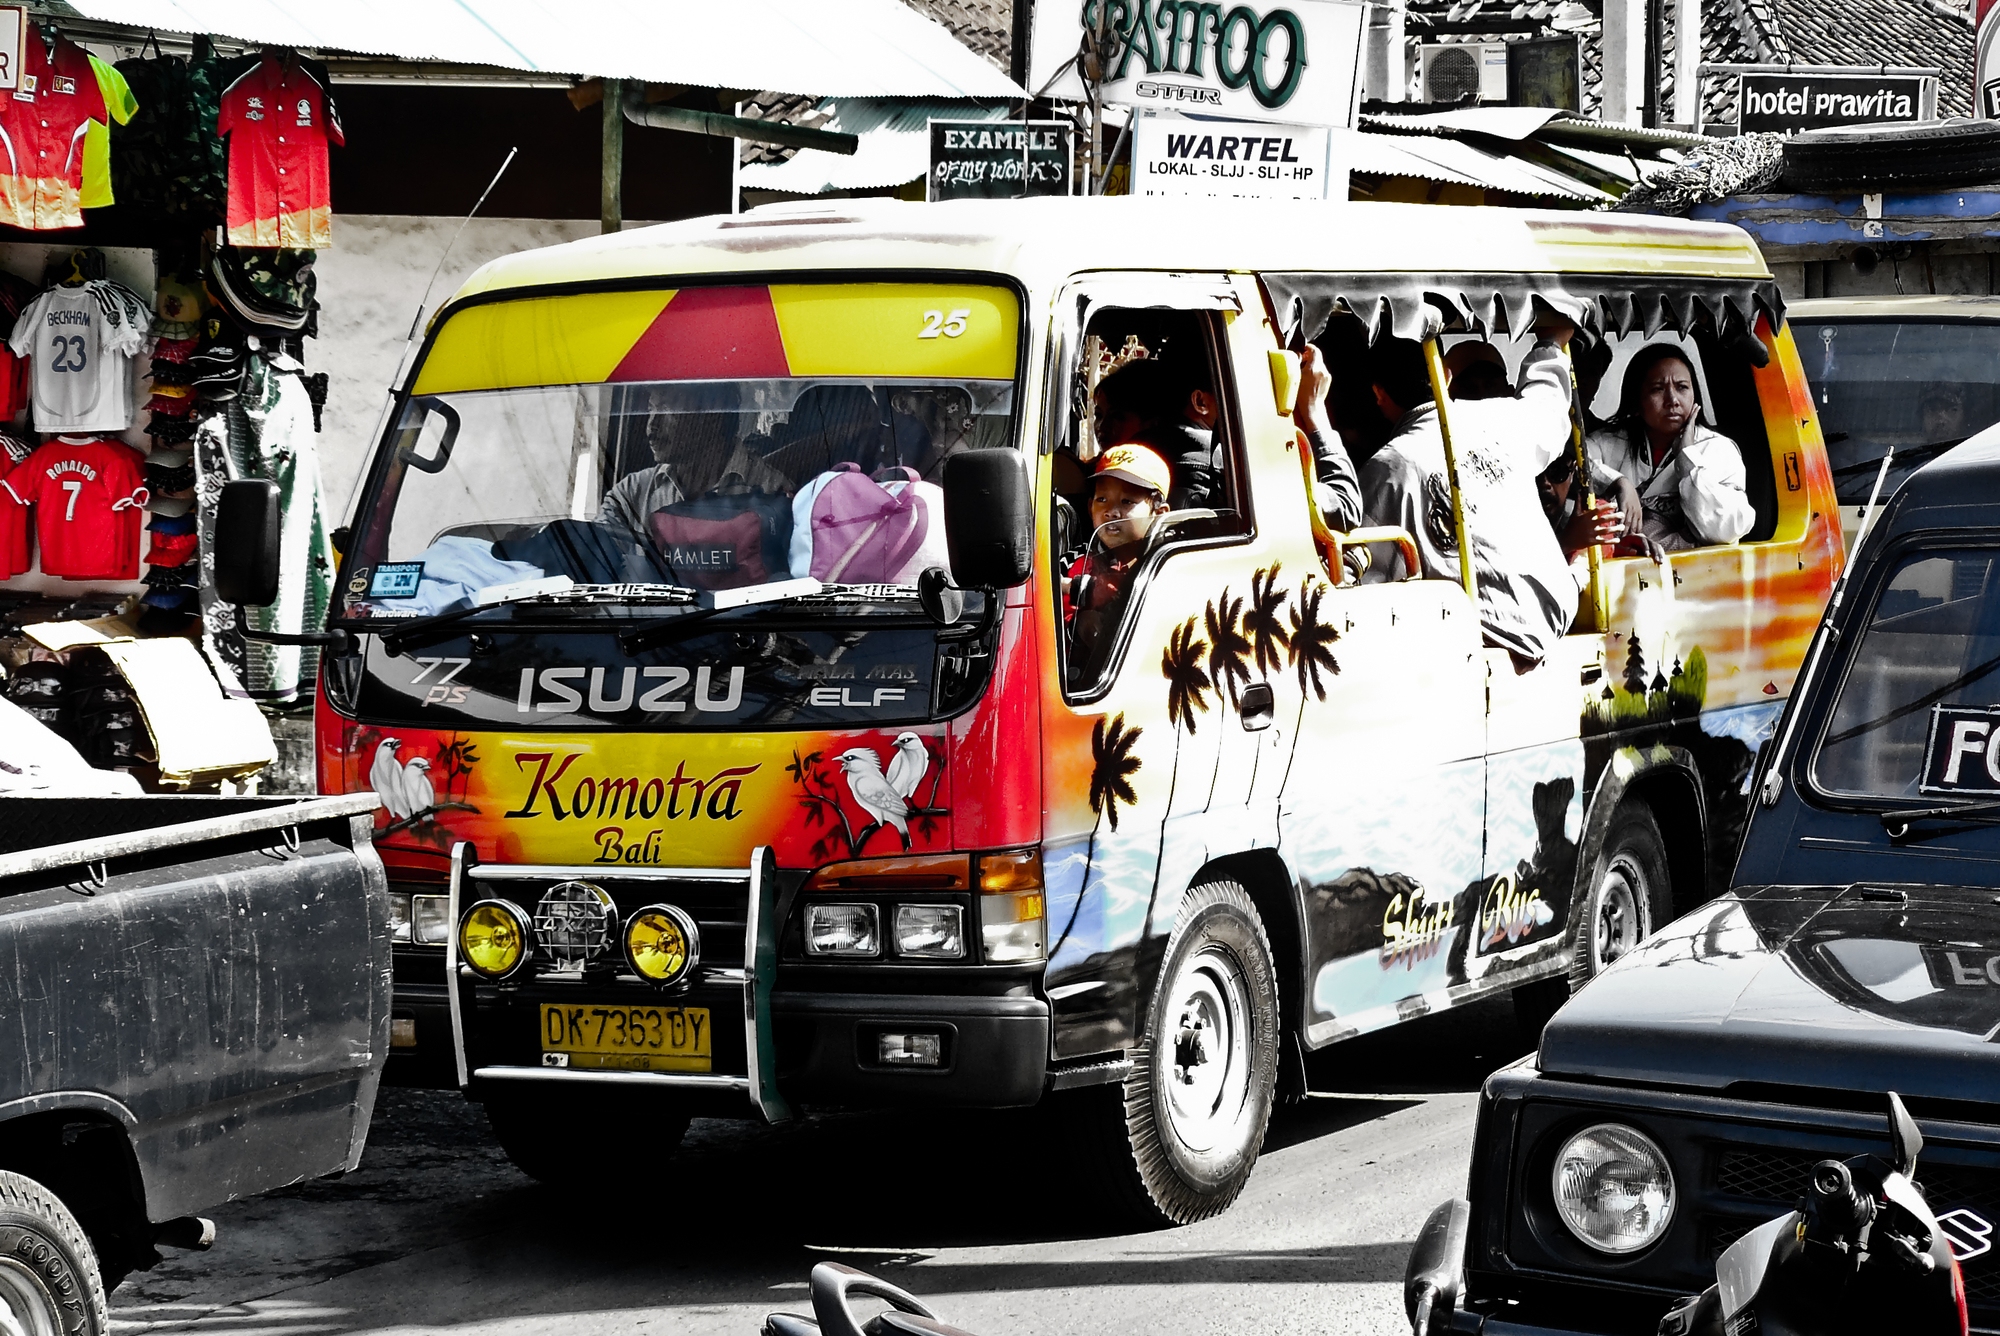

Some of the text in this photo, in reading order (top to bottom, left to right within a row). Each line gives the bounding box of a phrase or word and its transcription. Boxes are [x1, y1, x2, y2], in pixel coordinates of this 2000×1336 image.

[1137, 81, 1222, 105] STAR
[1746, 86, 1912, 117] hotel prawita
[944, 130, 1057, 150] EXAMPLE
[1167, 134, 1298, 163] WARTEL
[1149, 161, 1198, 176] LOKAL
[1211, 164, 1244, 177] SLJJ
[1258, 166, 1280, 179] SLI
[1293, 168, 1313, 180] HP
[47, 310, 90, 327] BECKHAM
[917, 309, 970, 339] 25
[52, 335, 87, 372] 23
[46, 460, 97, 481] RONALDO
[62, 481, 81, 521] 7
[664, 547, 732, 565] HAMLET
[371, 608, 418, 618] Hardware
[410, 656, 472, 684] 77
[517, 666, 745, 713] ISUZU
[810, 687, 906, 707] ELF
[504, 752, 763, 822] Komotra
[593, 825, 664, 864] Bali
